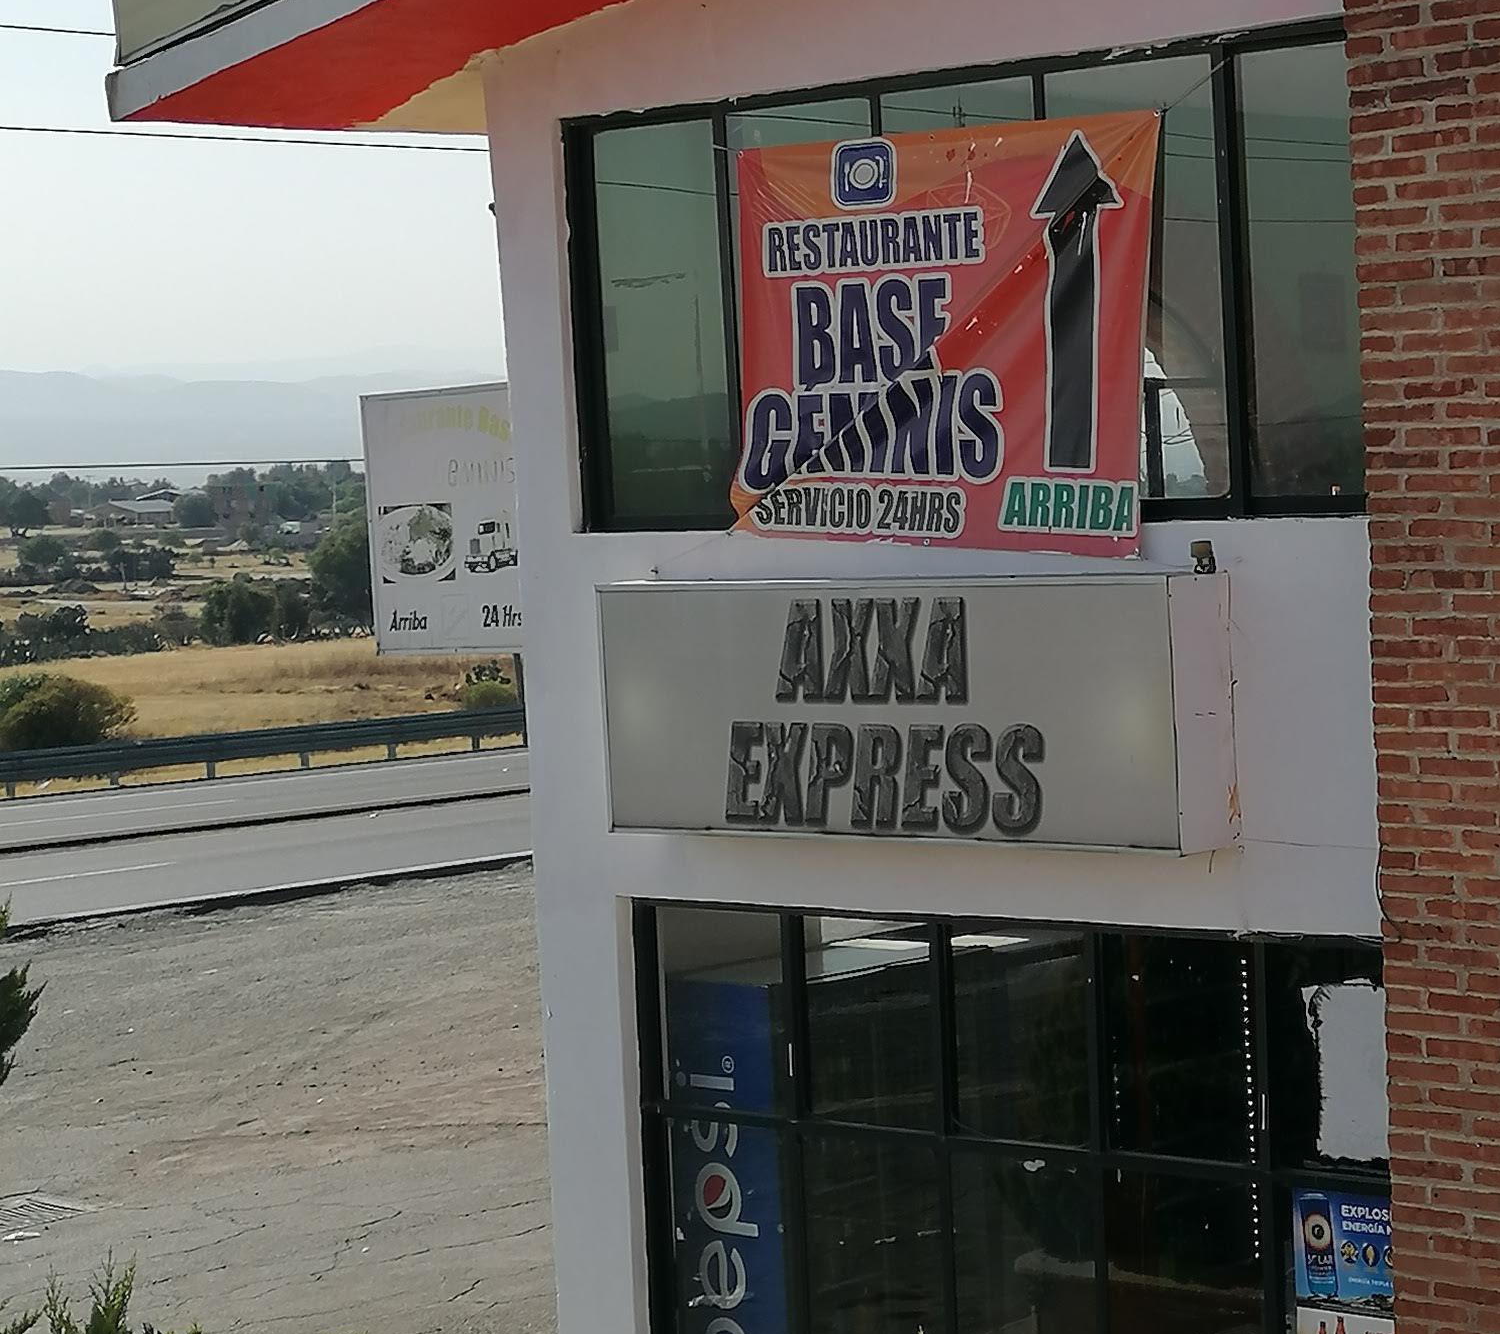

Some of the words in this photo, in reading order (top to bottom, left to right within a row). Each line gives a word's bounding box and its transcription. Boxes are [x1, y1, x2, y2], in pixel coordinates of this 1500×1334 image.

[767, 211, 981, 273] RESTAURANTE
[796, 277, 947, 385] BASE
[478, 405, 512, 443] Bas
[755, 487, 872, 529] SERVICIO
[1003, 481, 1135, 532] ARRIBA
[389, 608, 428, 632] Arriba
[482, 605, 500, 628] 24
[502, 605, 523, 628] Hrs
[775, 595, 970, 703] AXXA
[724, 720, 1047, 836] EXPRESS
